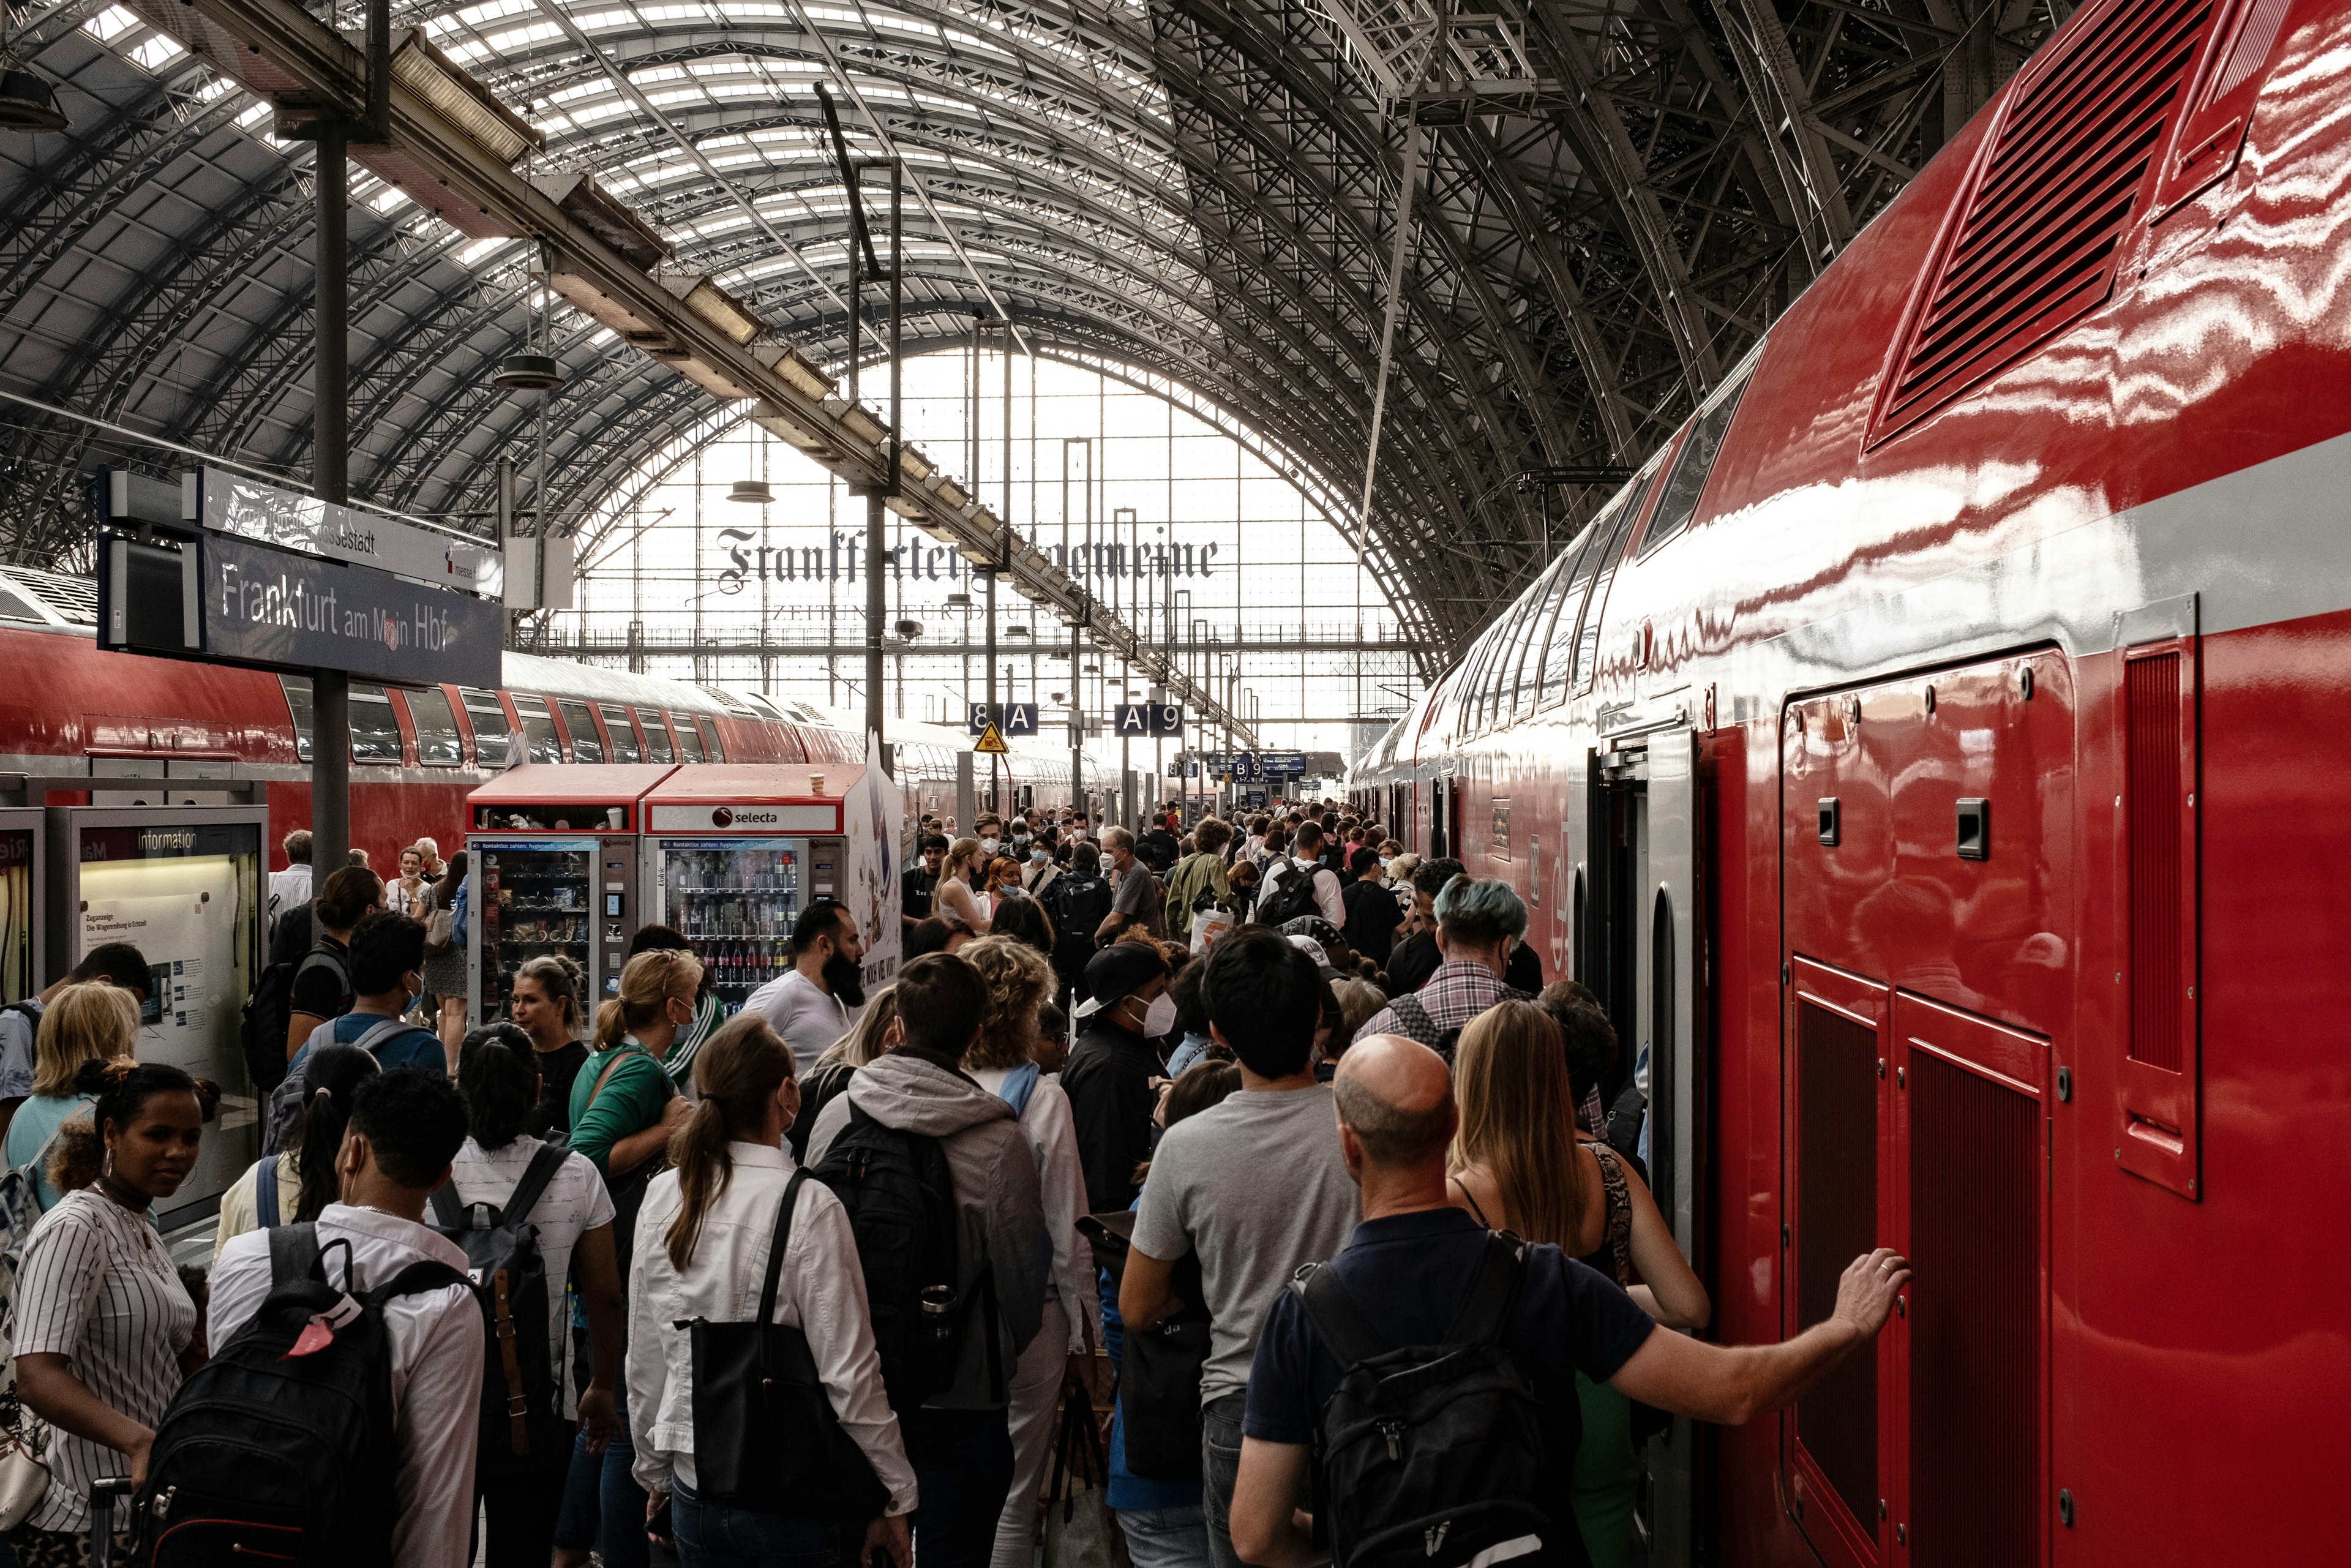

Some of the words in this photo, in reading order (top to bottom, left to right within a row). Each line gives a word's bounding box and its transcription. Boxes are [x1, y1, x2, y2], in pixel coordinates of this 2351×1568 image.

[455, 565, 473, 579] messe
[716, 528, 961, 596] Frankfrter
[222, 563, 337, 634] Frankfurt
[345, 610, 367, 639] am
[373, 607, 408, 648] Min
[415, 603, 448, 652] Hbf
[772, 604, 868, 621] ZEITUN
[975, 703, 987, 729] 8
[1010, 704, 1029, 729] A
[1122, 706, 1142, 730] A
[1163, 706, 1179, 730] 9
[1237, 763, 1245, 775] B
[1253, 763, 1261, 775] 9
[735, 812, 777, 823] selecta
[138, 829, 197, 850] Information
[86, 912, 114, 923] Zuganzeige
